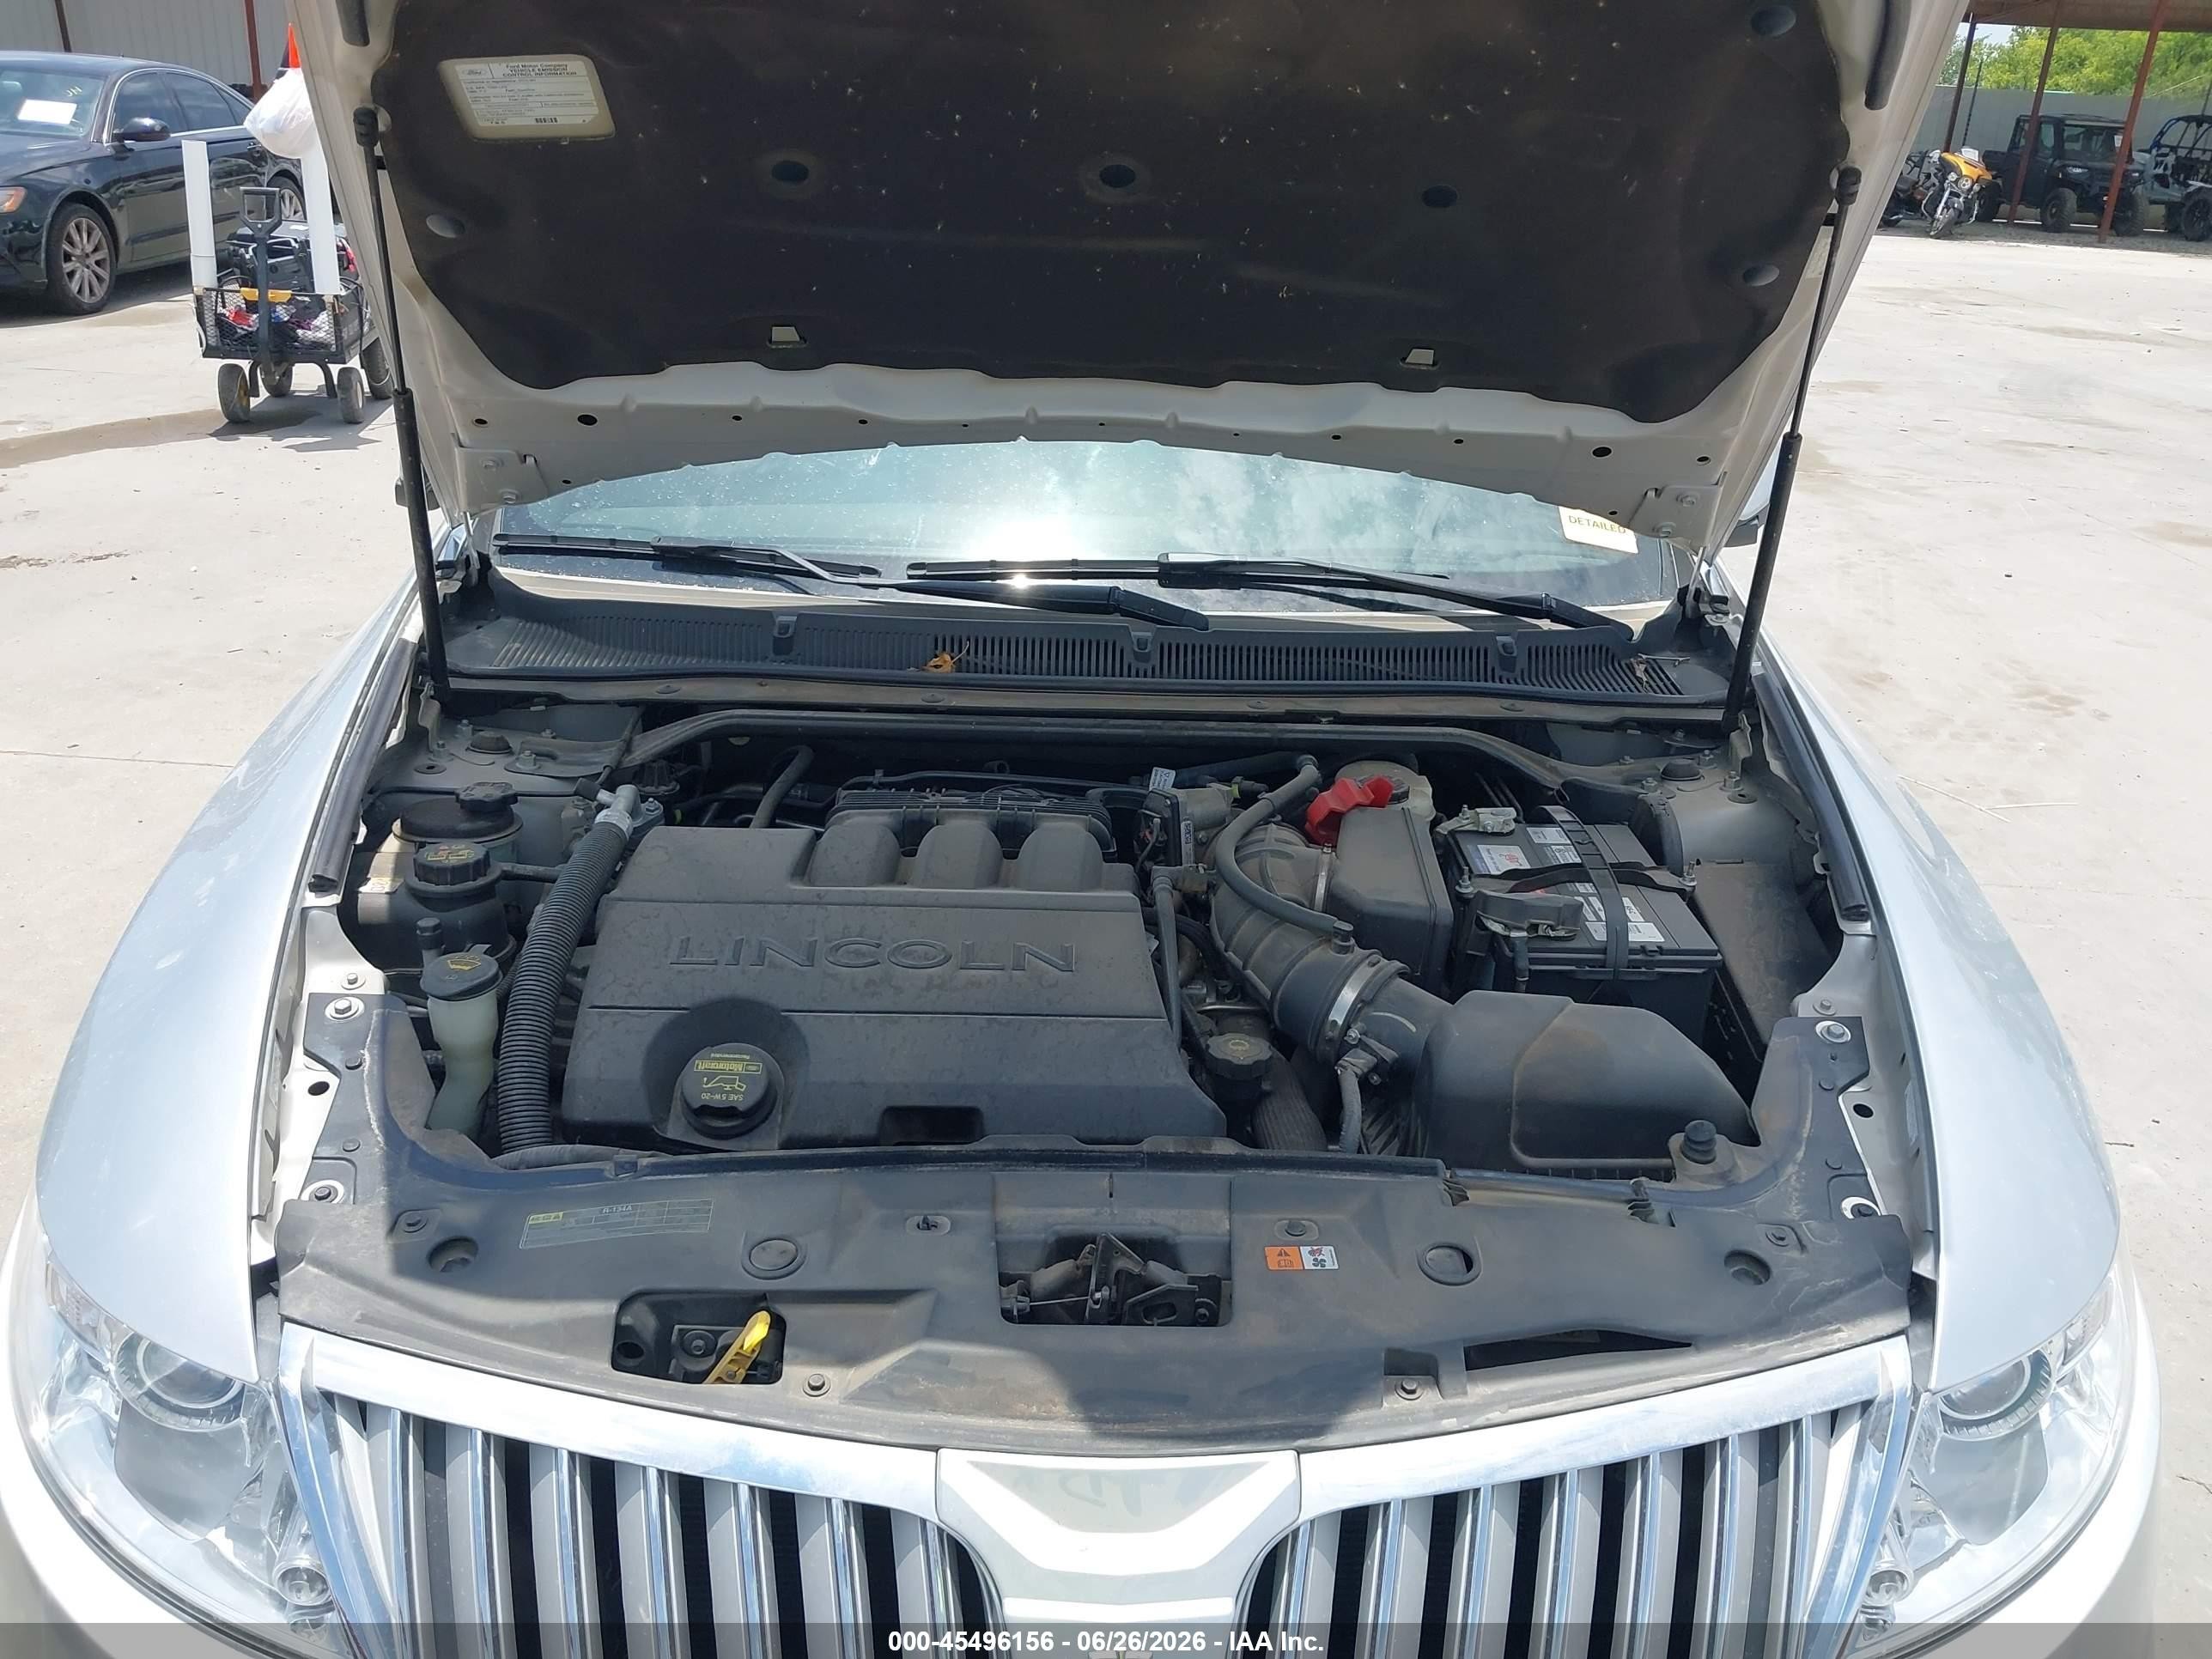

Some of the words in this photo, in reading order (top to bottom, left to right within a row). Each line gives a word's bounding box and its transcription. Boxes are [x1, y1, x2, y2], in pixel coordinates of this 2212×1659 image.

[1569, 515, 1626, 533] DETAILED
[670, 937, 1075, 972] LINCOLN
[697, 1062, 743, 1072] Motorcraft
